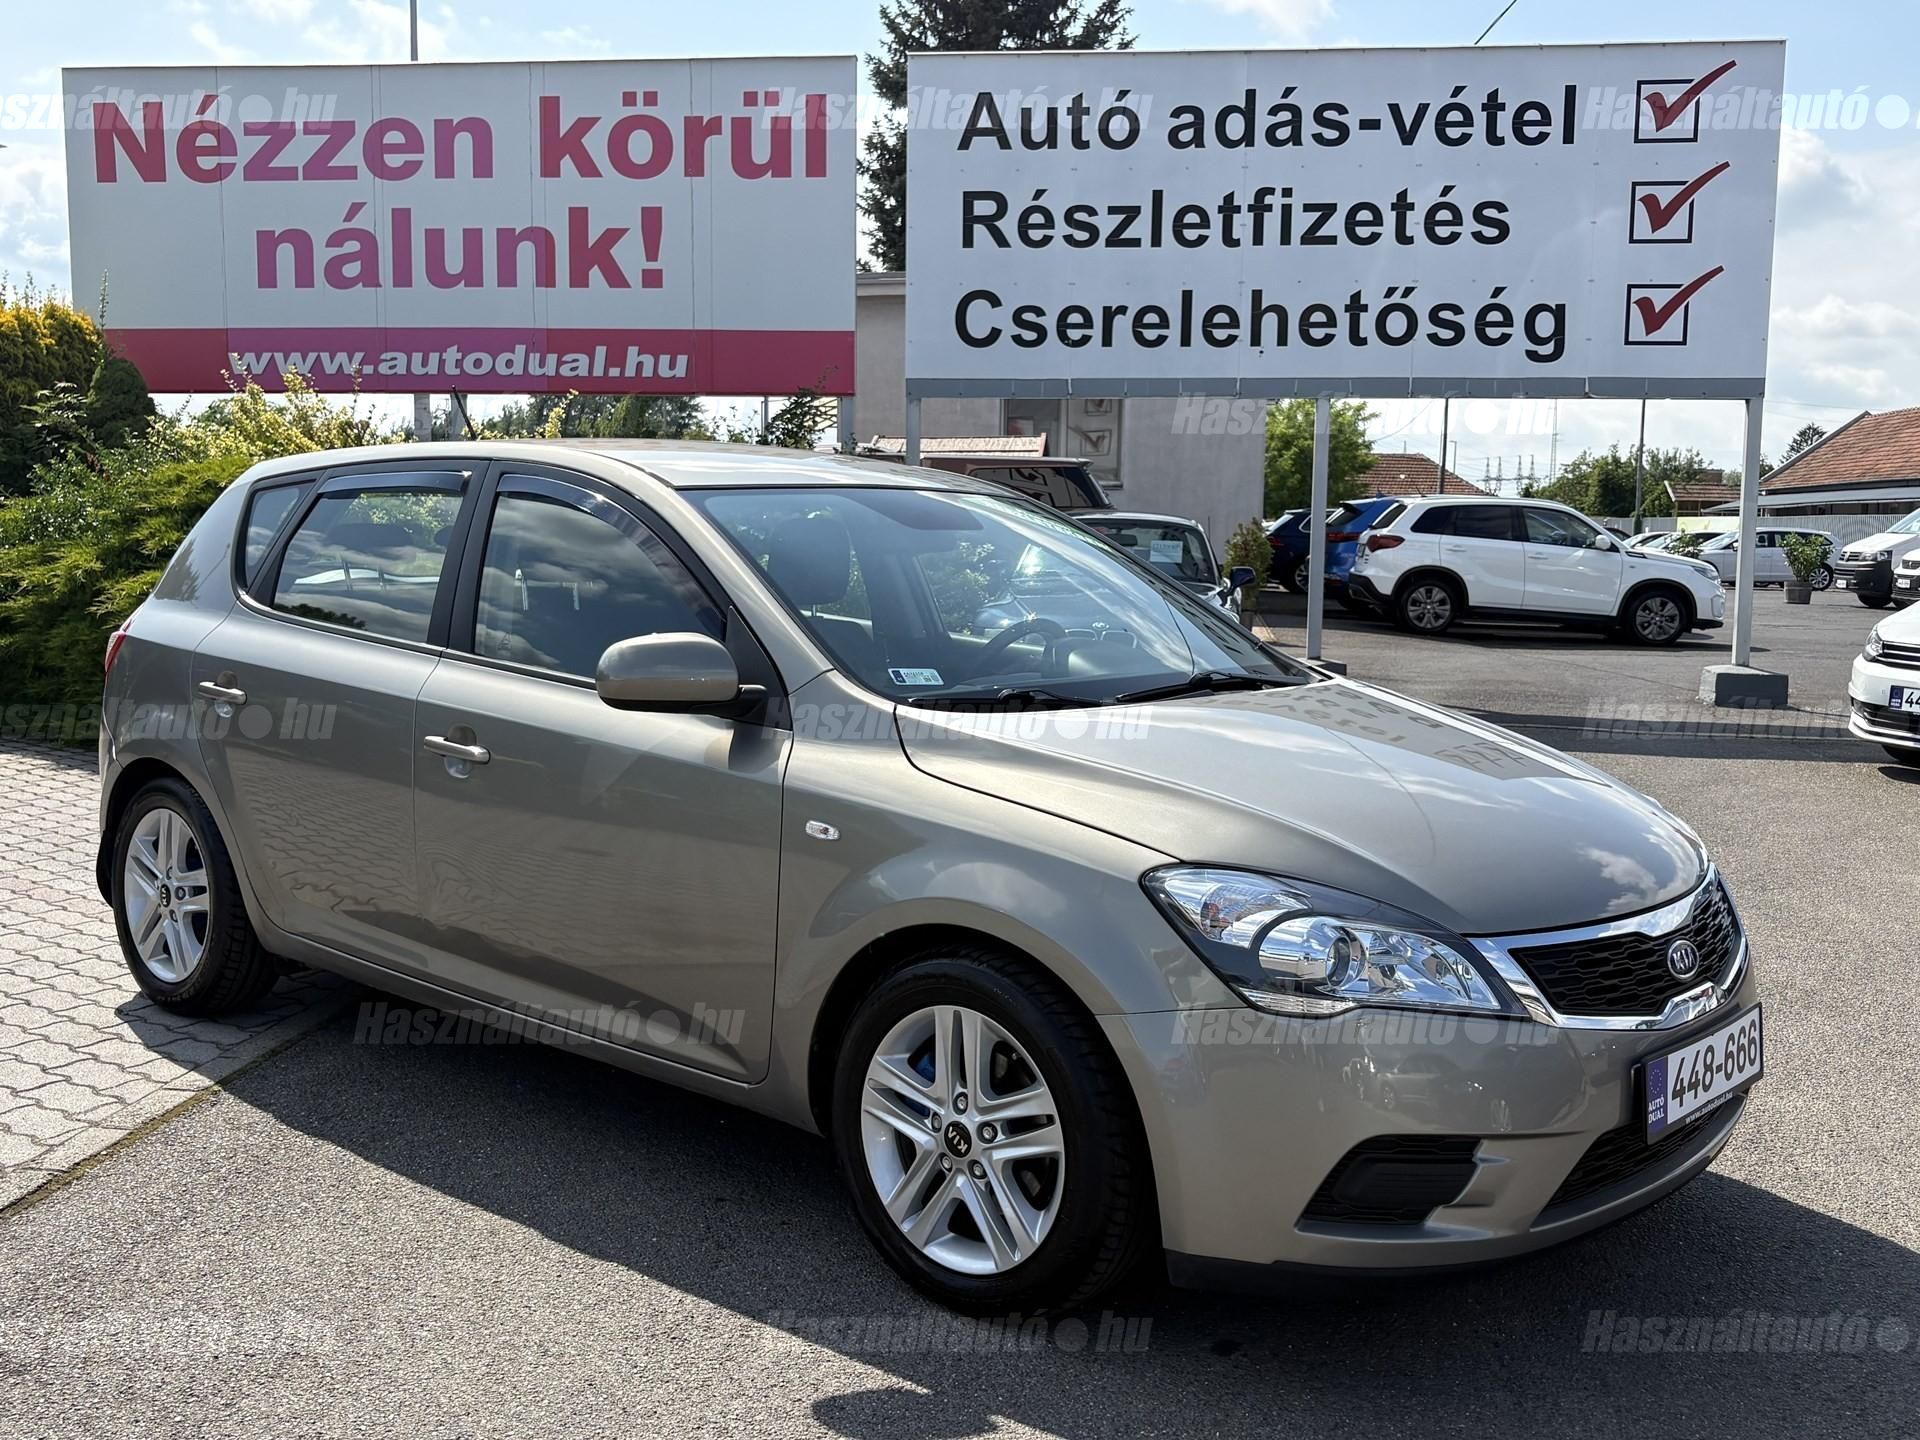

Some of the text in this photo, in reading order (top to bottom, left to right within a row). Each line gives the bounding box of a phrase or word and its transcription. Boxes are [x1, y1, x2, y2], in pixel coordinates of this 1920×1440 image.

[92, 90, 828, 185] Nézzen körül
[957, 83, 1577, 152] Autó adás-vétel
[256, 202, 664, 290] nálunk!
[961, 184, 1511, 250] Részletfizetés
[953, 284, 1568, 363] Cserelehetőség
[228, 344, 689, 379] www.autodual.hu
[1671, 1019, 1758, 1108] 448-666
[947, 1126, 968, 1154] KIA
[1648, 1111, 1665, 1124] DUAL
